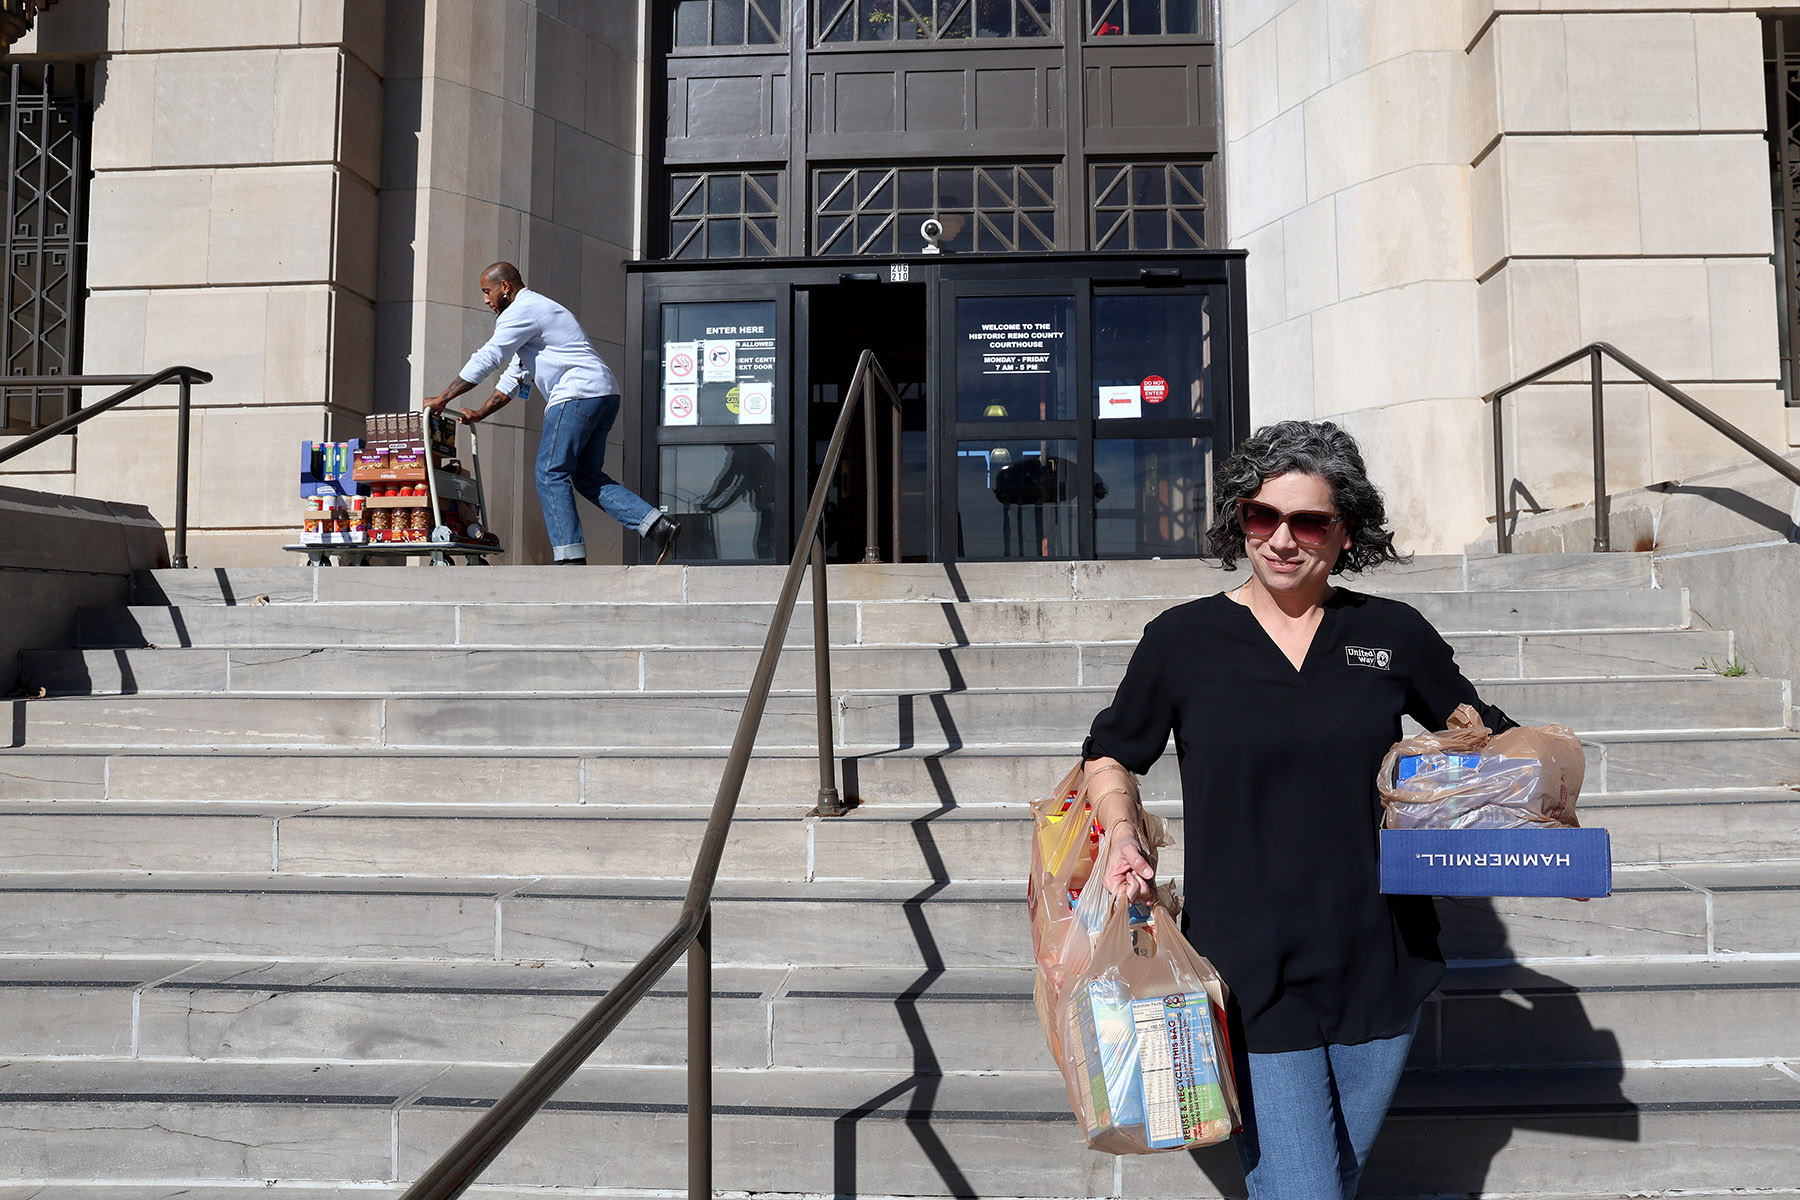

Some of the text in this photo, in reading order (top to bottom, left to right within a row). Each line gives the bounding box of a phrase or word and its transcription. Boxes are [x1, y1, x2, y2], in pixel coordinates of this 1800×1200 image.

[891, 263, 908, 272] 206
[891, 272, 908, 281] 210
[706, 325, 765, 335] ENTER HERE
[1347, 648, 1374, 657] United
[1358, 656, 1375, 665] Way
[1421, 853, 1570, 867] HAMMERMILL
[1168, 1020, 1177, 1040] BAG
[1171, 1042, 1180, 1061] THIS
[1174, 1062, 1186, 1102] RECYCLE
[1181, 1114, 1191, 1140] REUSE
